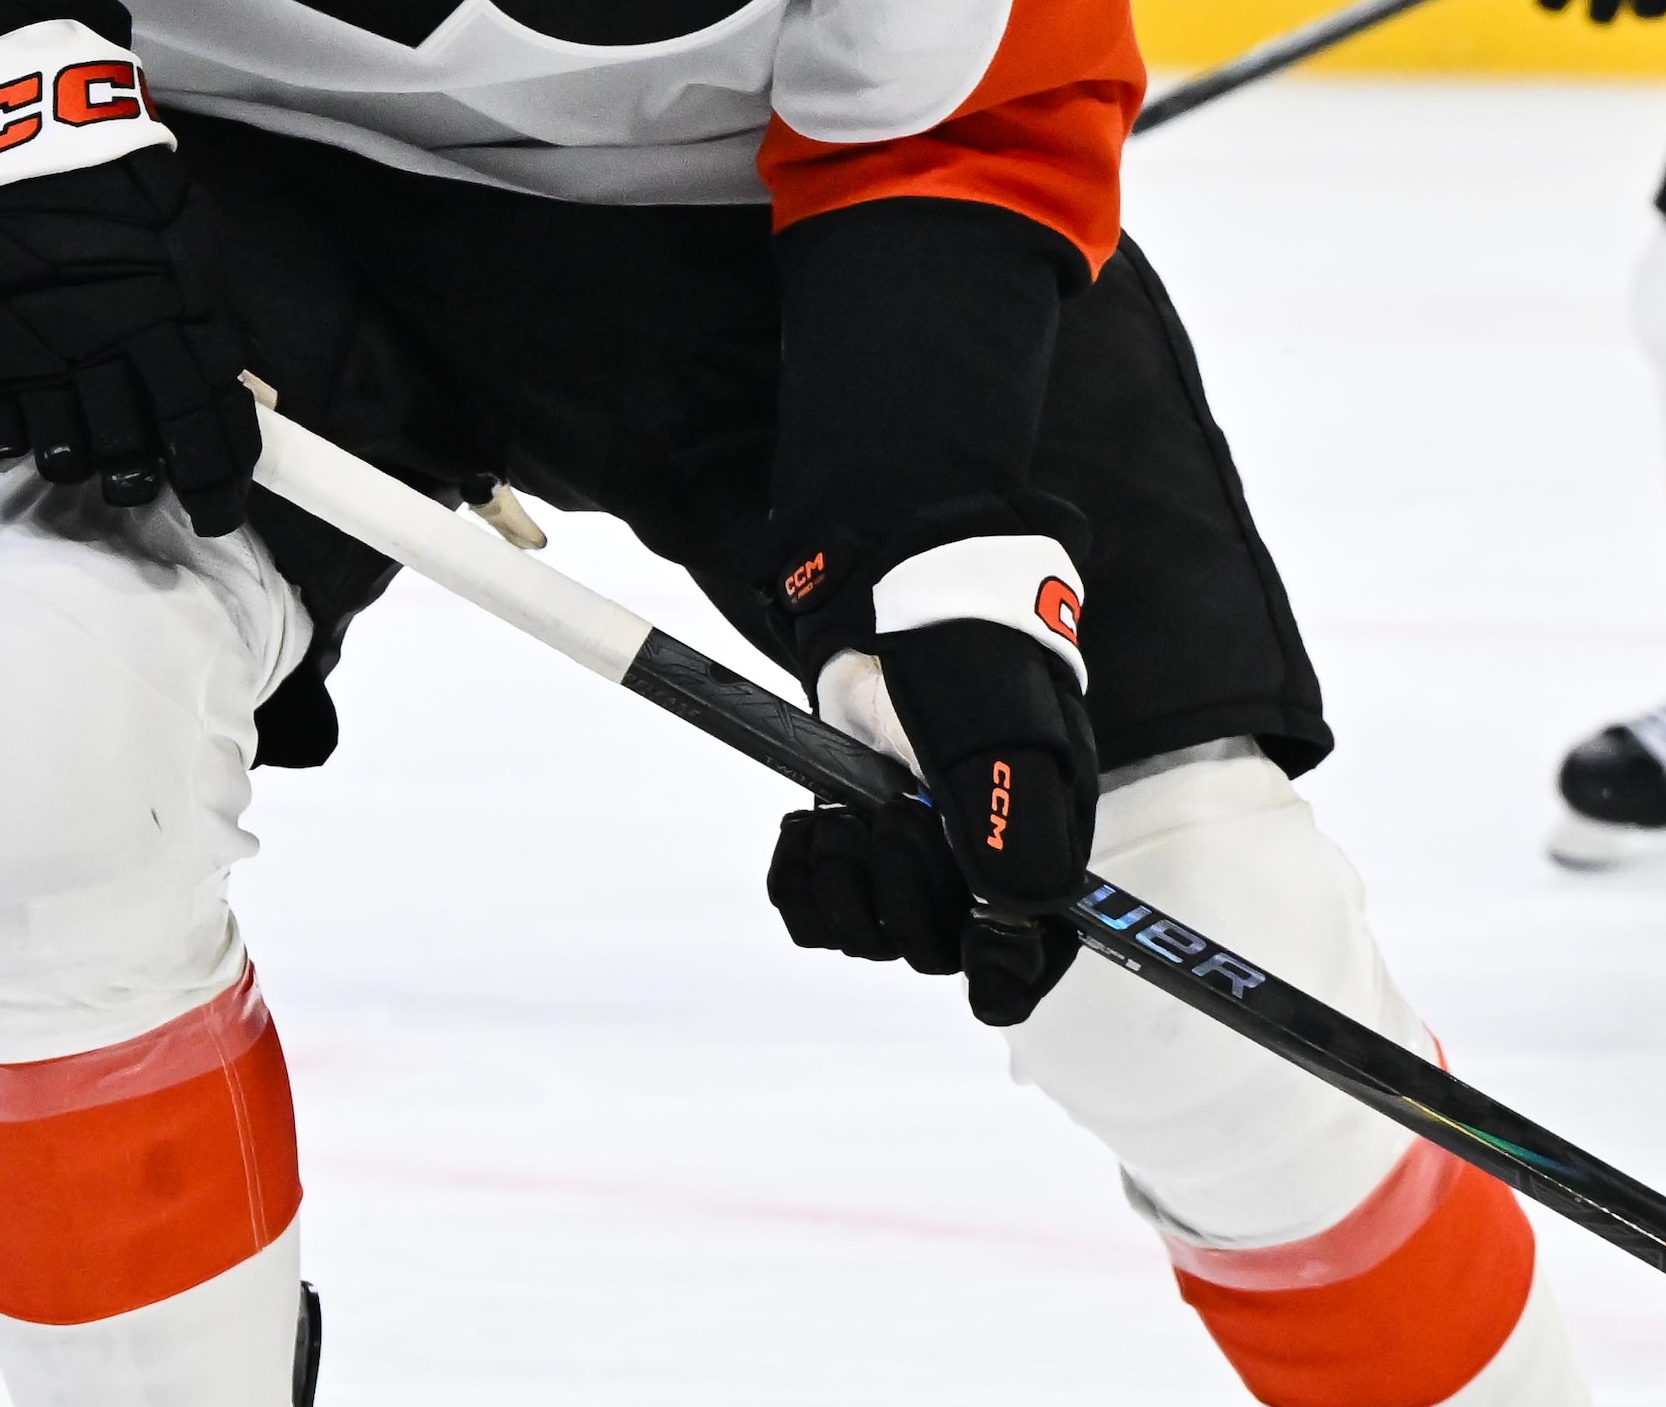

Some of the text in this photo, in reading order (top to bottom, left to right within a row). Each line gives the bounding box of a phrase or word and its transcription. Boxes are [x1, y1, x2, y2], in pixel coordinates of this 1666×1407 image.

[785, 552, 824, 596] CCM
[987, 760, 1011, 851] CCM
[1076, 884, 1266, 1000] UER
